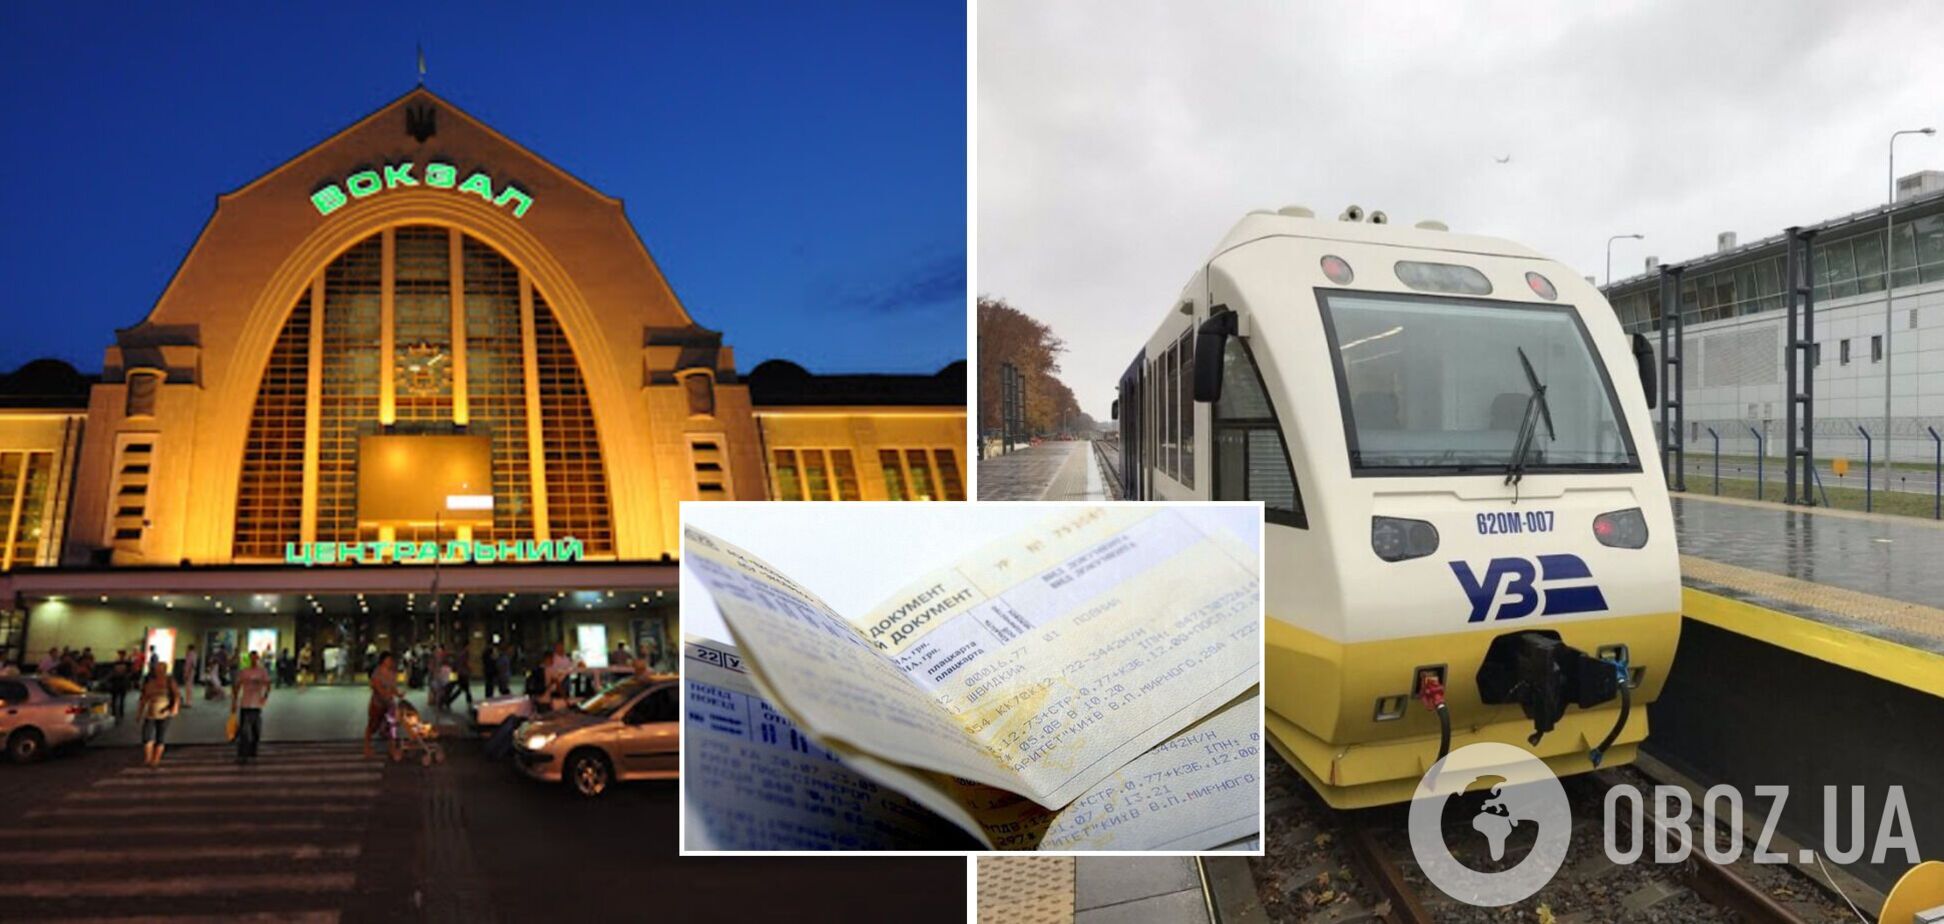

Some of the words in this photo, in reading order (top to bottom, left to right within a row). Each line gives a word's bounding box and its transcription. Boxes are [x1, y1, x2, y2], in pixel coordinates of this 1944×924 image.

[311, 163, 533, 218] ВОКЗАЛ
[286, 536, 584, 565] ЦЕНТРАЛЬНИЙ
[869, 583, 947, 638] ДОКУМЕНТ
[890, 588, 973, 645] ДОКУМЕНТ
[697, 648, 718, 662] 22
[927, 641, 977, 675] плацкарта
[935, 648, 985, 682] плацкарта
